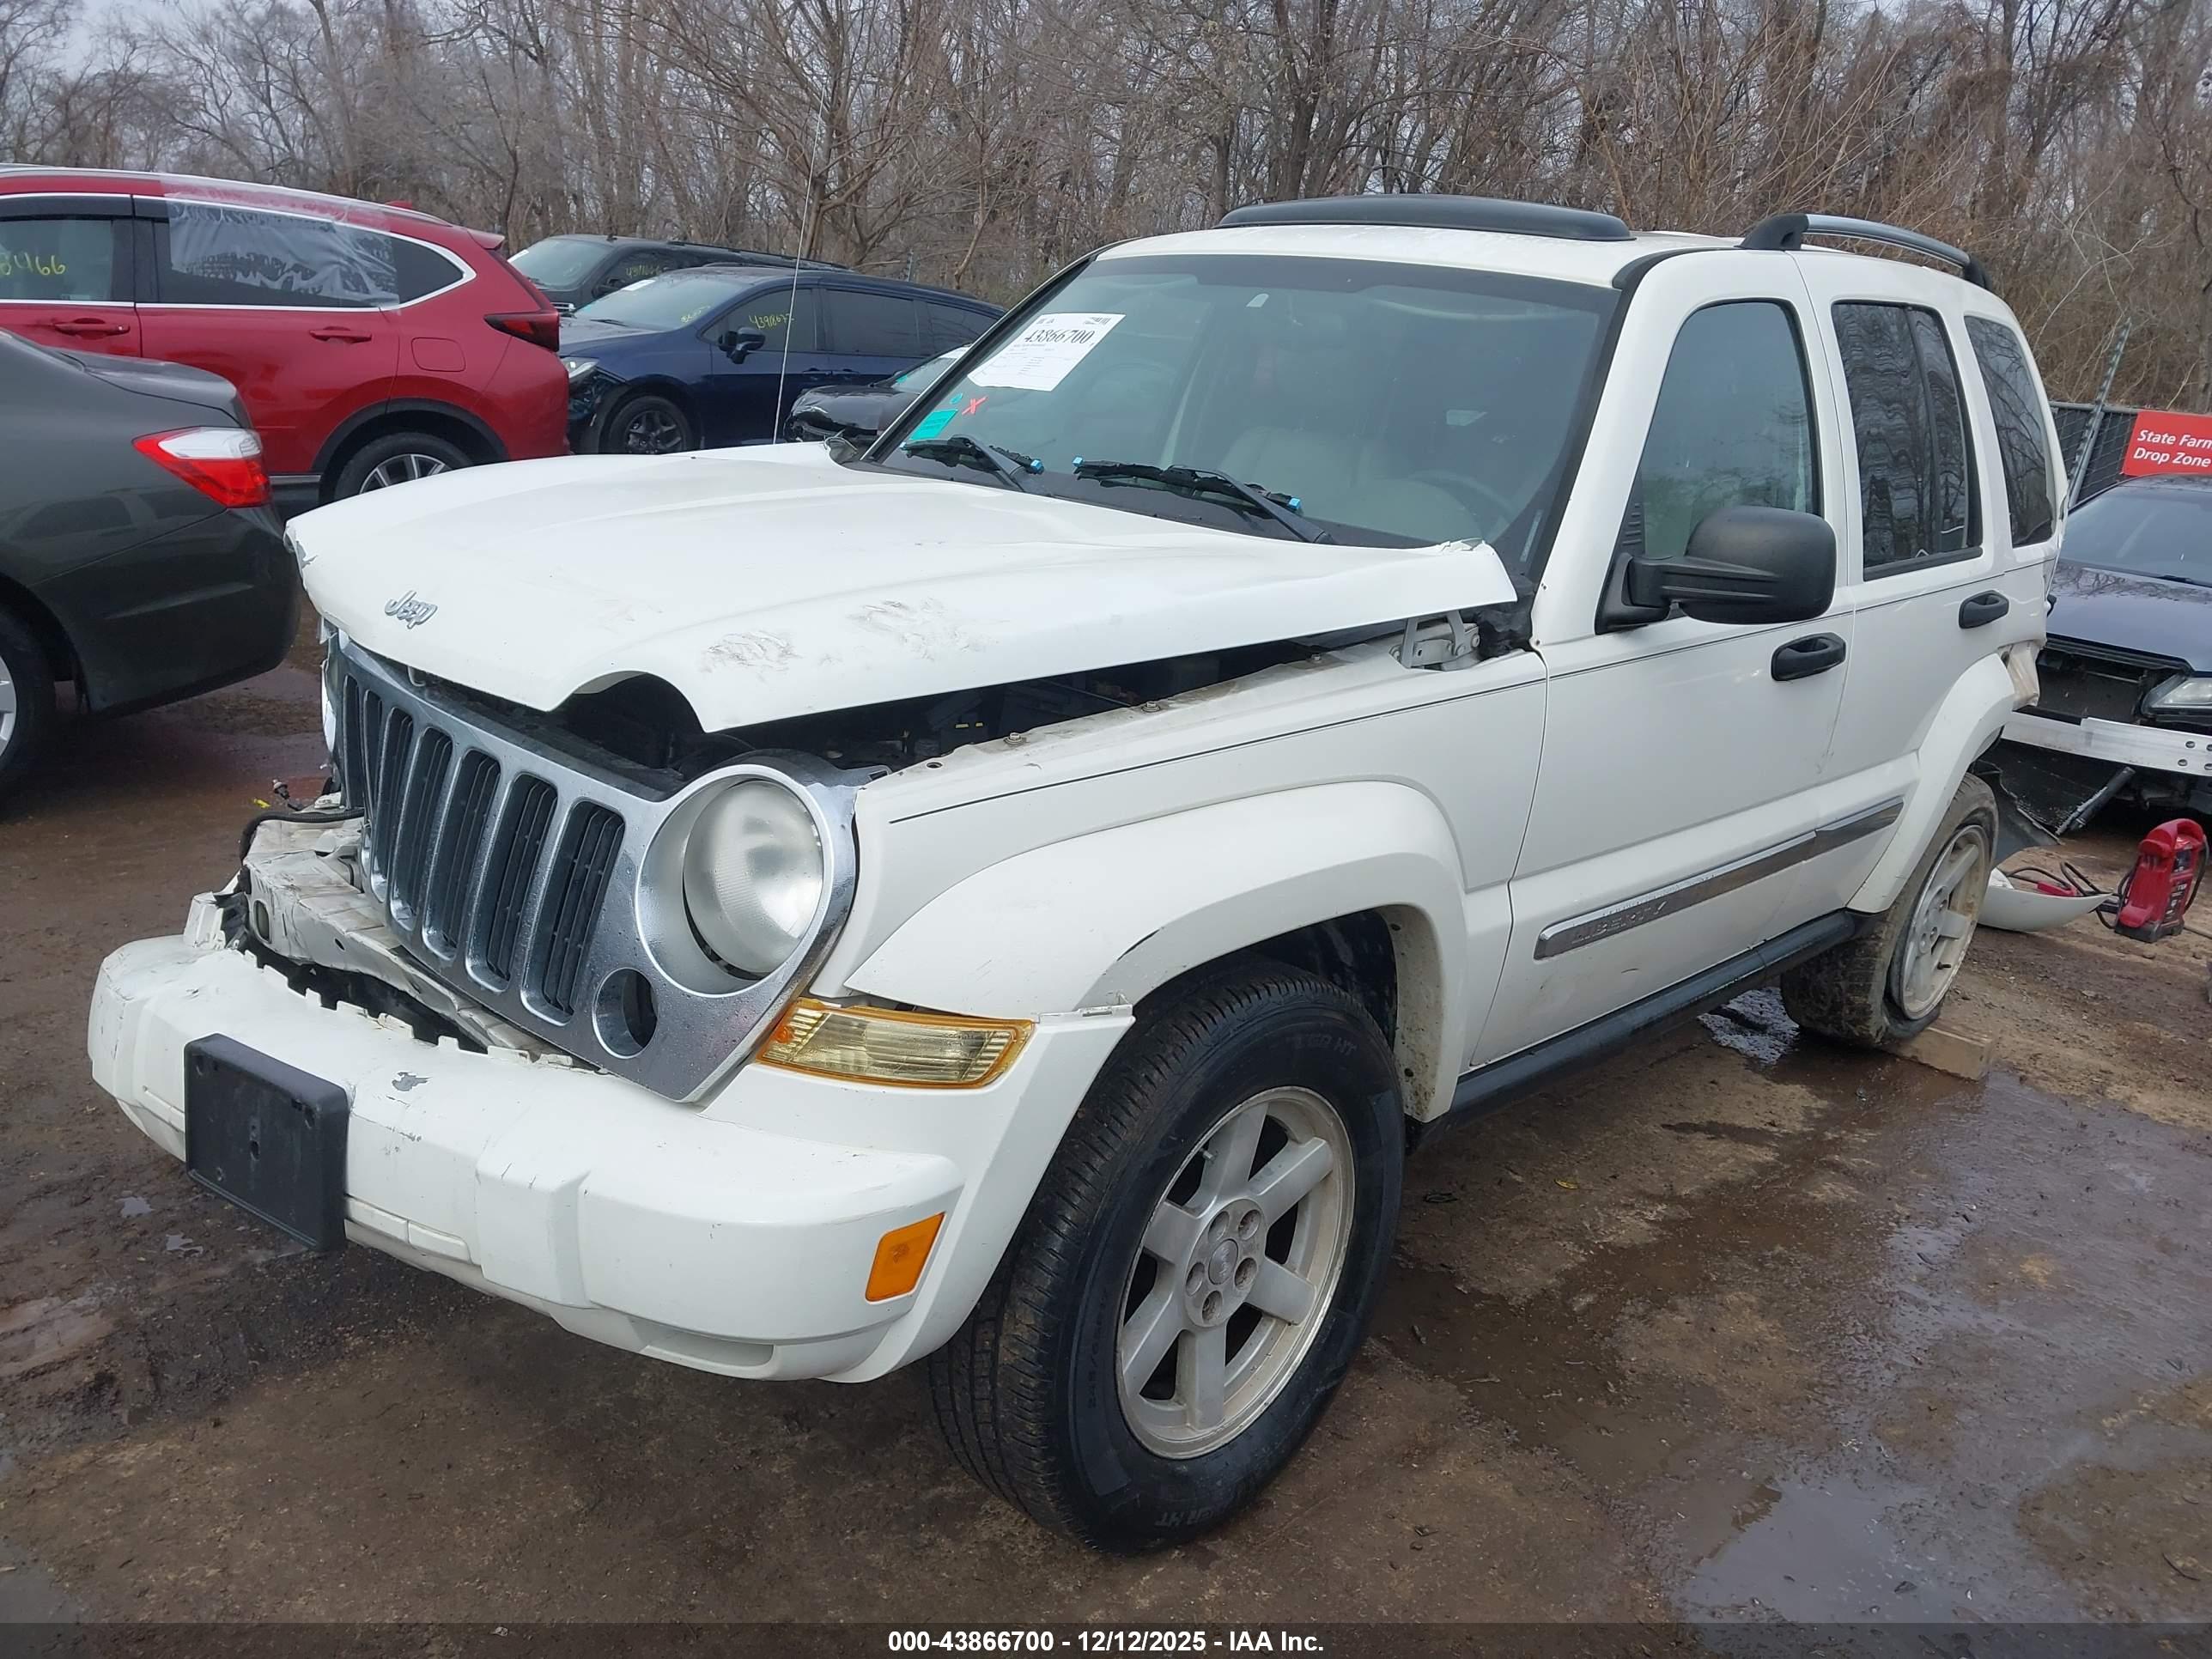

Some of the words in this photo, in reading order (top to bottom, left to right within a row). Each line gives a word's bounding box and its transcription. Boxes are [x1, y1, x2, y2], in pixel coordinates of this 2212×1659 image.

[1024, 329, 1095, 343] 43866700
[2137, 430, 2176, 445] State
[2134, 447, 2170, 465] Drop
[2172, 453, 2211, 467] Zone
[384, 590, 438, 629] Jeep
